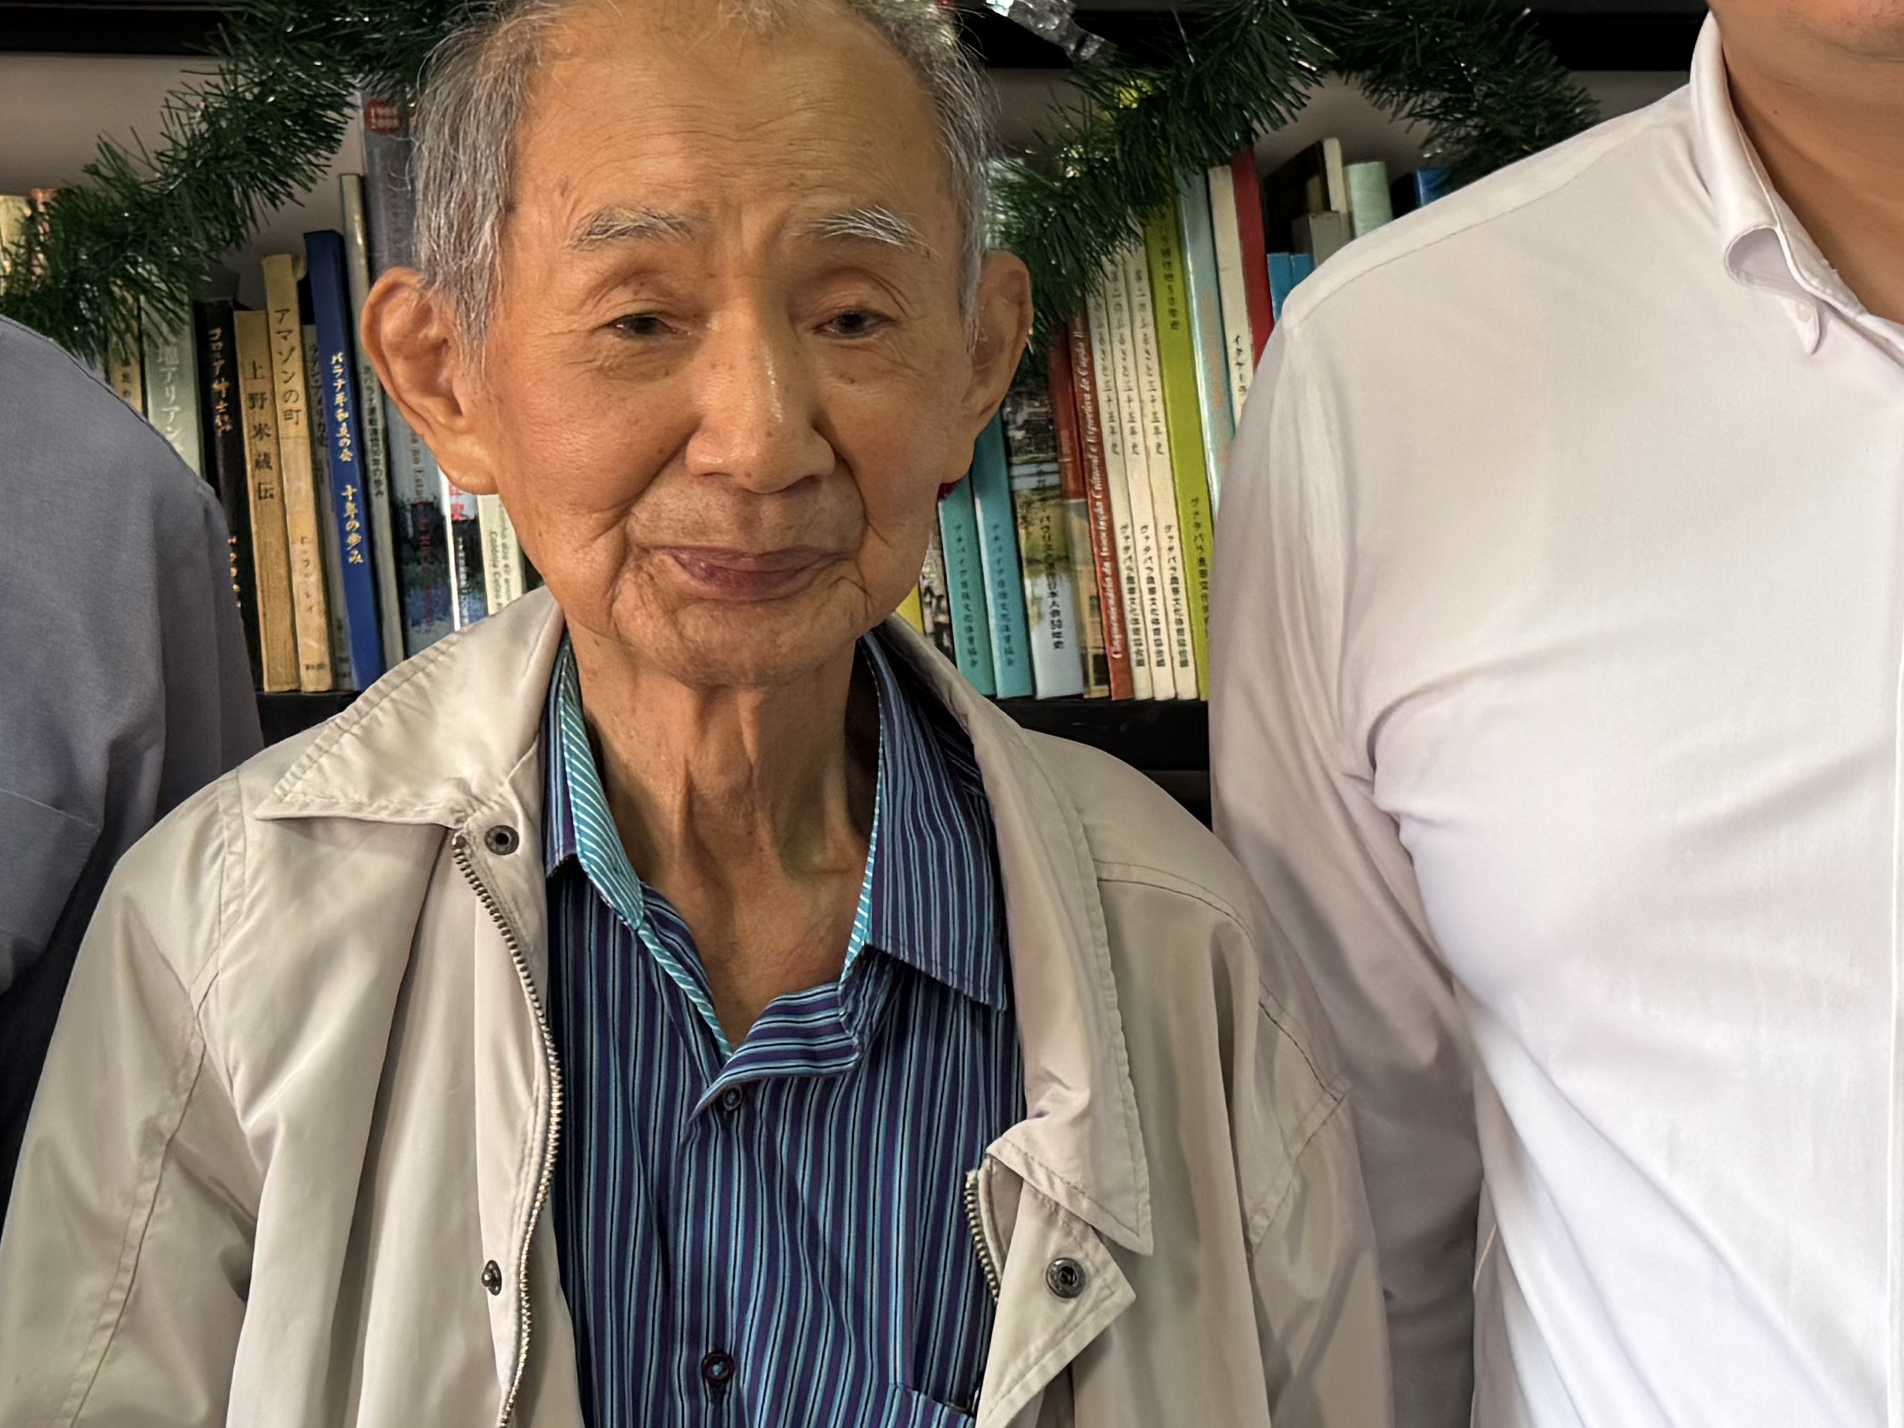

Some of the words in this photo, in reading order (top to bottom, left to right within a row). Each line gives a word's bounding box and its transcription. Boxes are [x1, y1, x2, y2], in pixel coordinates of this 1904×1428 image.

[246, 360, 276, 502] 上野米蔵伝
[275, 307, 302, 426] アマゾンの町
